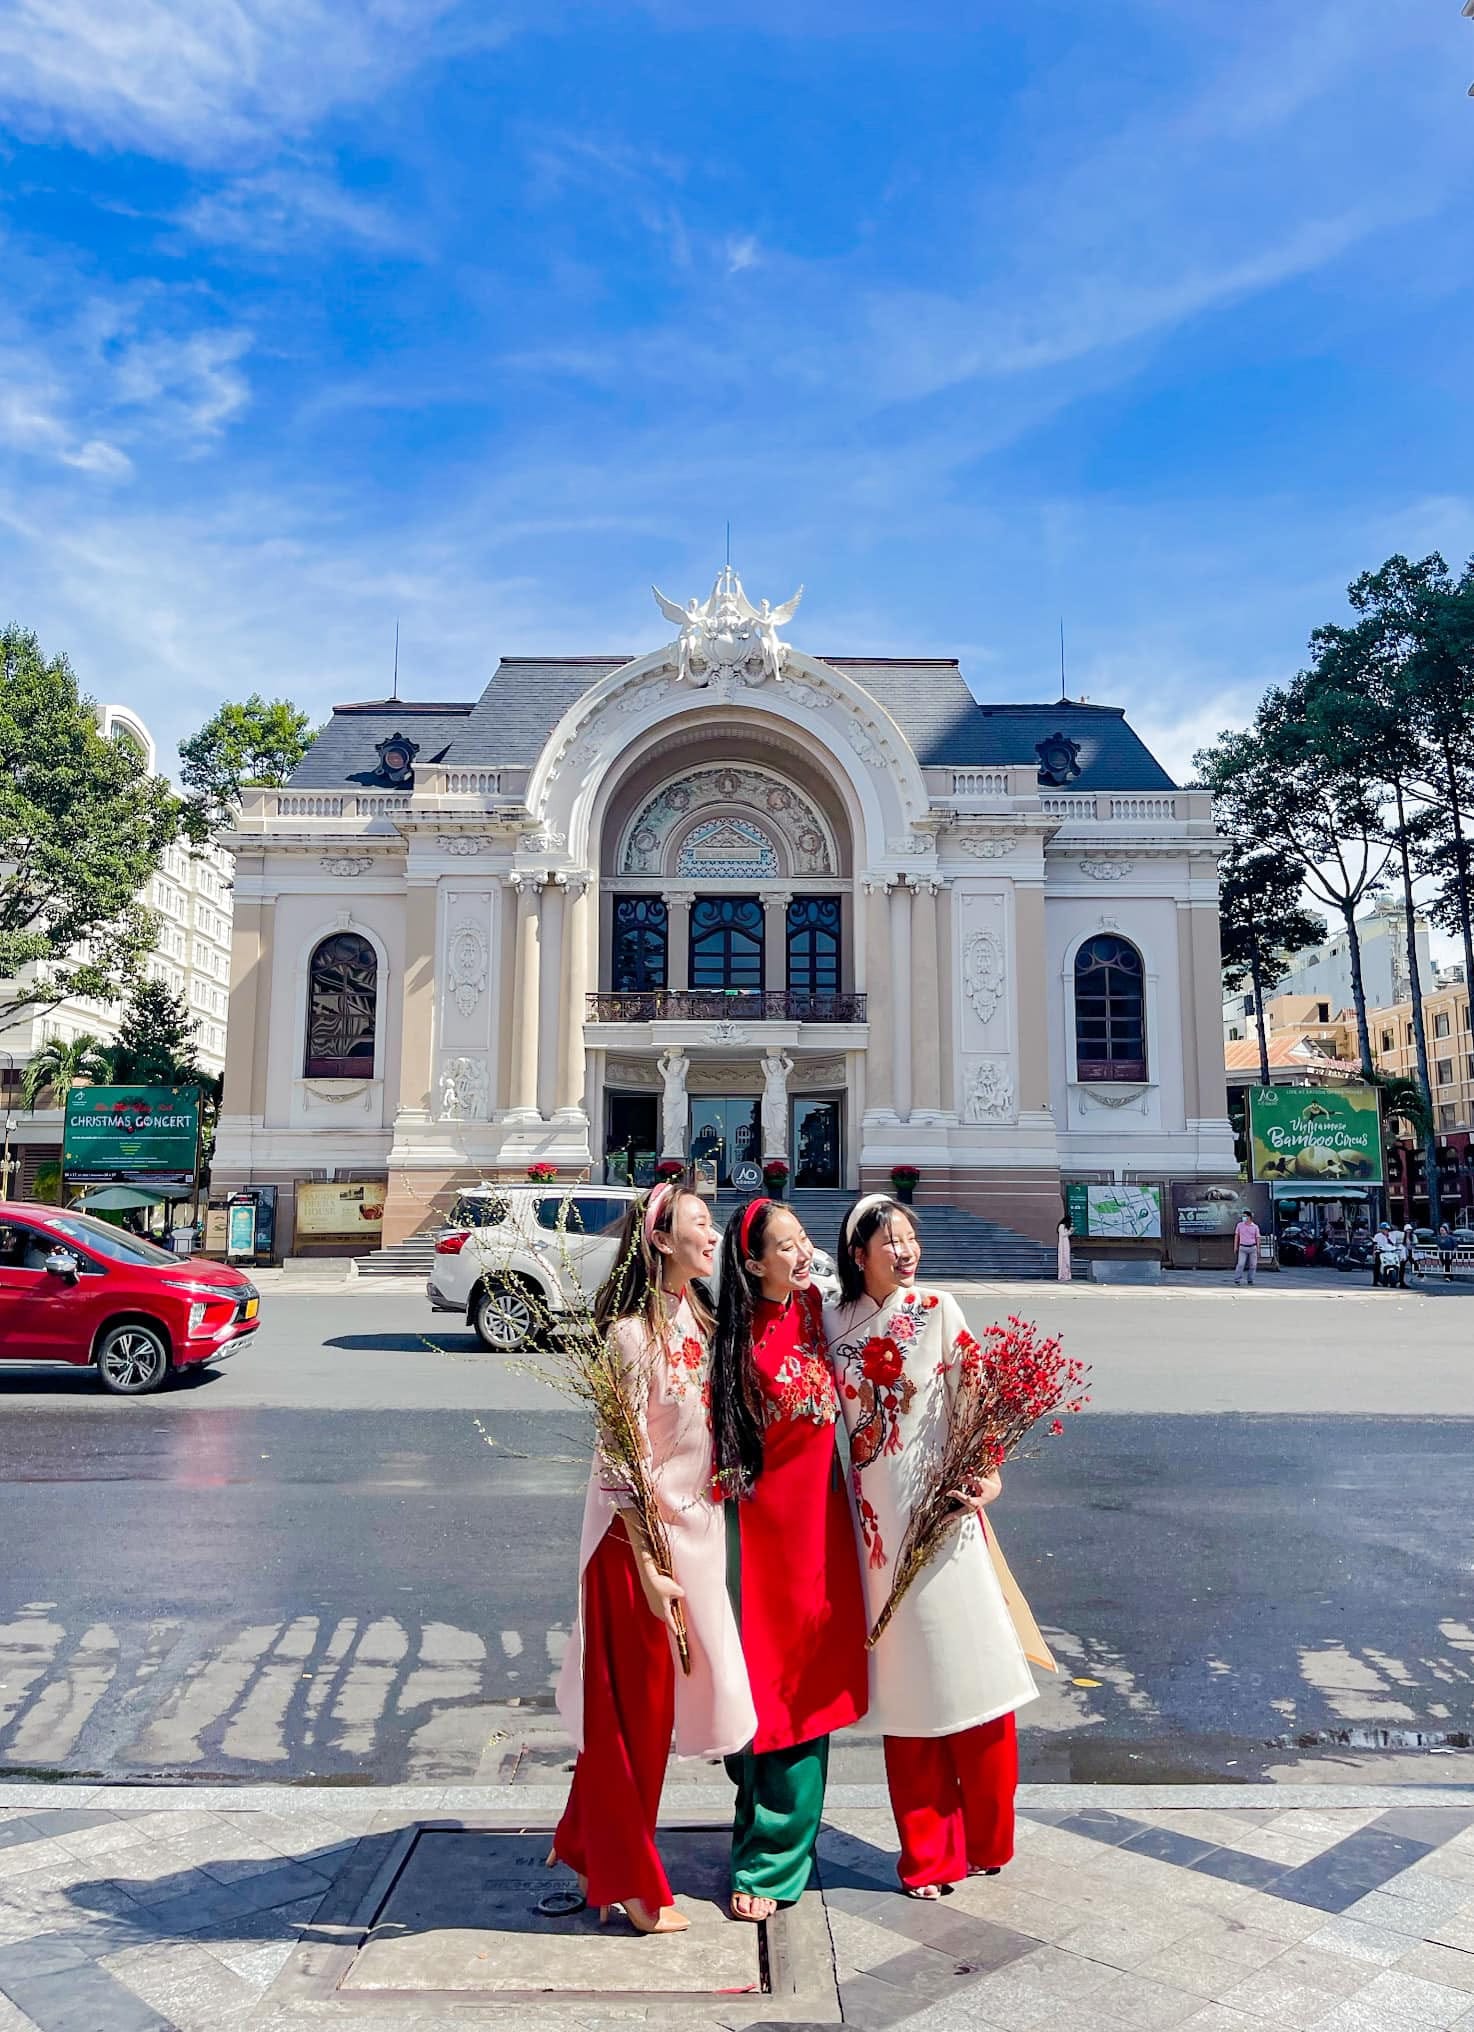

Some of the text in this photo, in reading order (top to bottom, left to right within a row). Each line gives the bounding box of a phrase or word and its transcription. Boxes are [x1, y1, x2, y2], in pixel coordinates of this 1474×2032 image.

[70, 1115, 192, 1128] CHRISTMAS CONCERT
[1290, 1117, 1347, 1133] Vietnamese
[1267, 1126, 1368, 1147] Bamboo Circus
